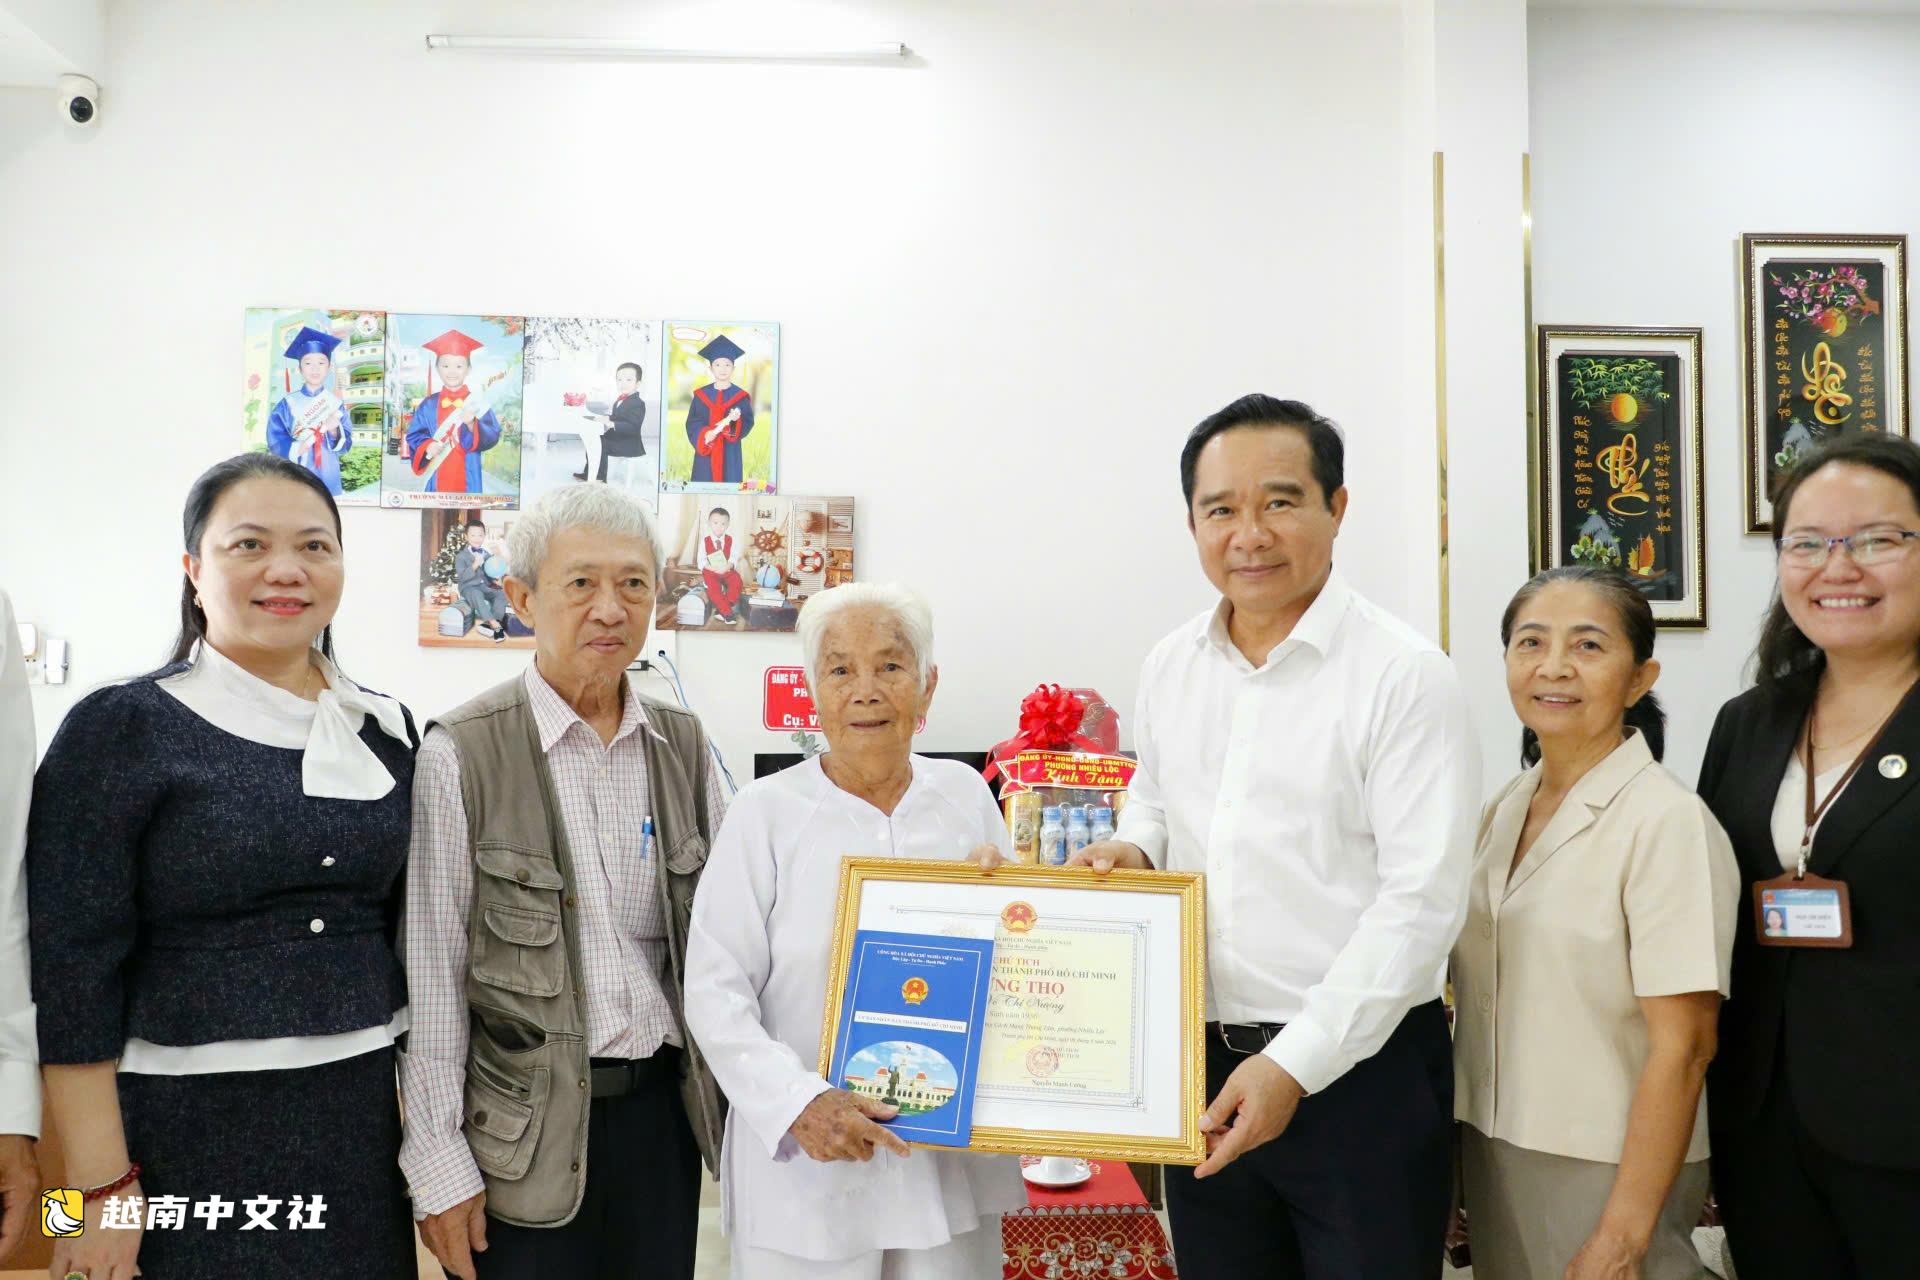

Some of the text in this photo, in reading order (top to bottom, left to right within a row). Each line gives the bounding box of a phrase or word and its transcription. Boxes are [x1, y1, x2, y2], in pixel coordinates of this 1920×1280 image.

[771, 671, 789, 684] ĐẢNG
[790, 671, 798, 684] ỦY
[783, 713, 804, 728] Cụ:
[1026, 980, 1065, 998] THỌ
